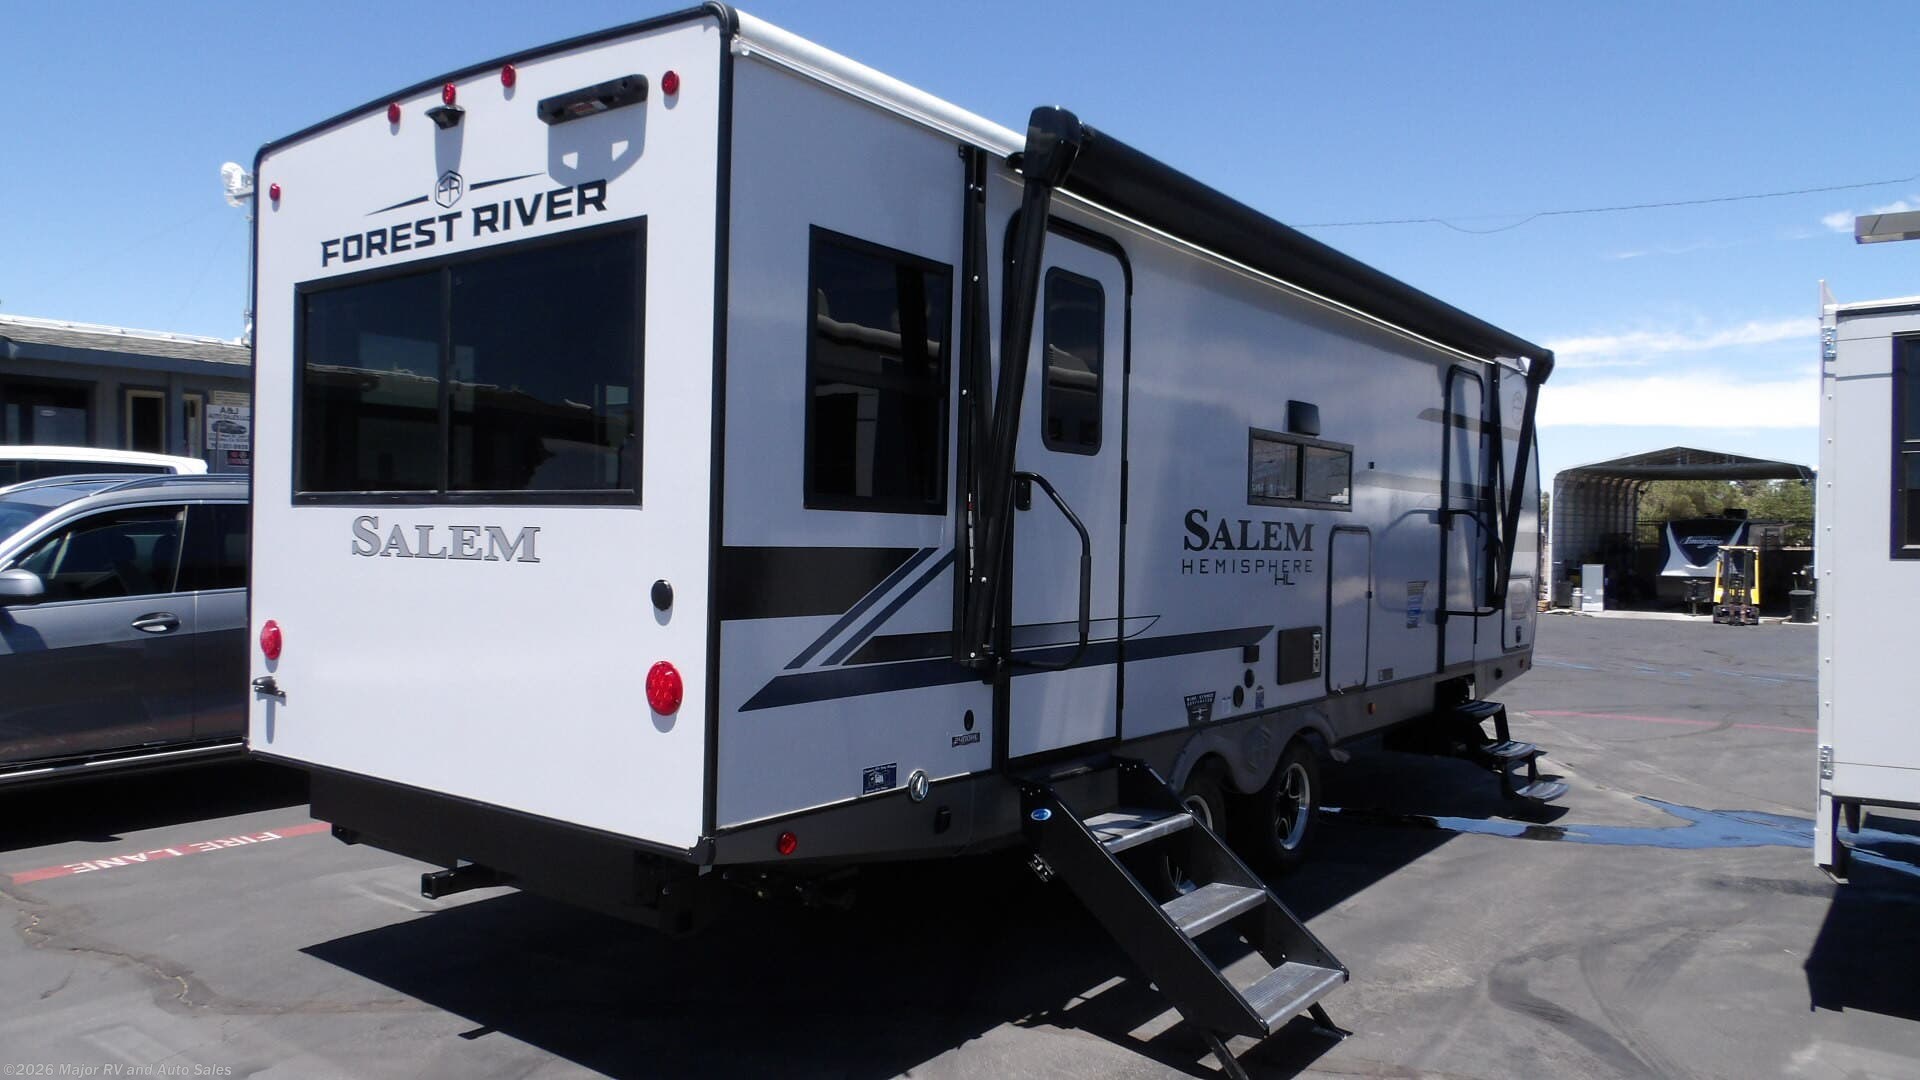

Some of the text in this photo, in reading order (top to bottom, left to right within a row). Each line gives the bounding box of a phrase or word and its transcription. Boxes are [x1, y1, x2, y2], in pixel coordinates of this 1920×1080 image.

[321, 179, 608, 267] FOREST RIVER
[352, 515, 541, 563] SALEM
[1184, 508, 1315, 551] SALEM
[1182, 558, 1312, 574] HEMISPHERE
[1274, 572, 1295, 585] HL
[63, 831, 282, 873] FIRE LANE
